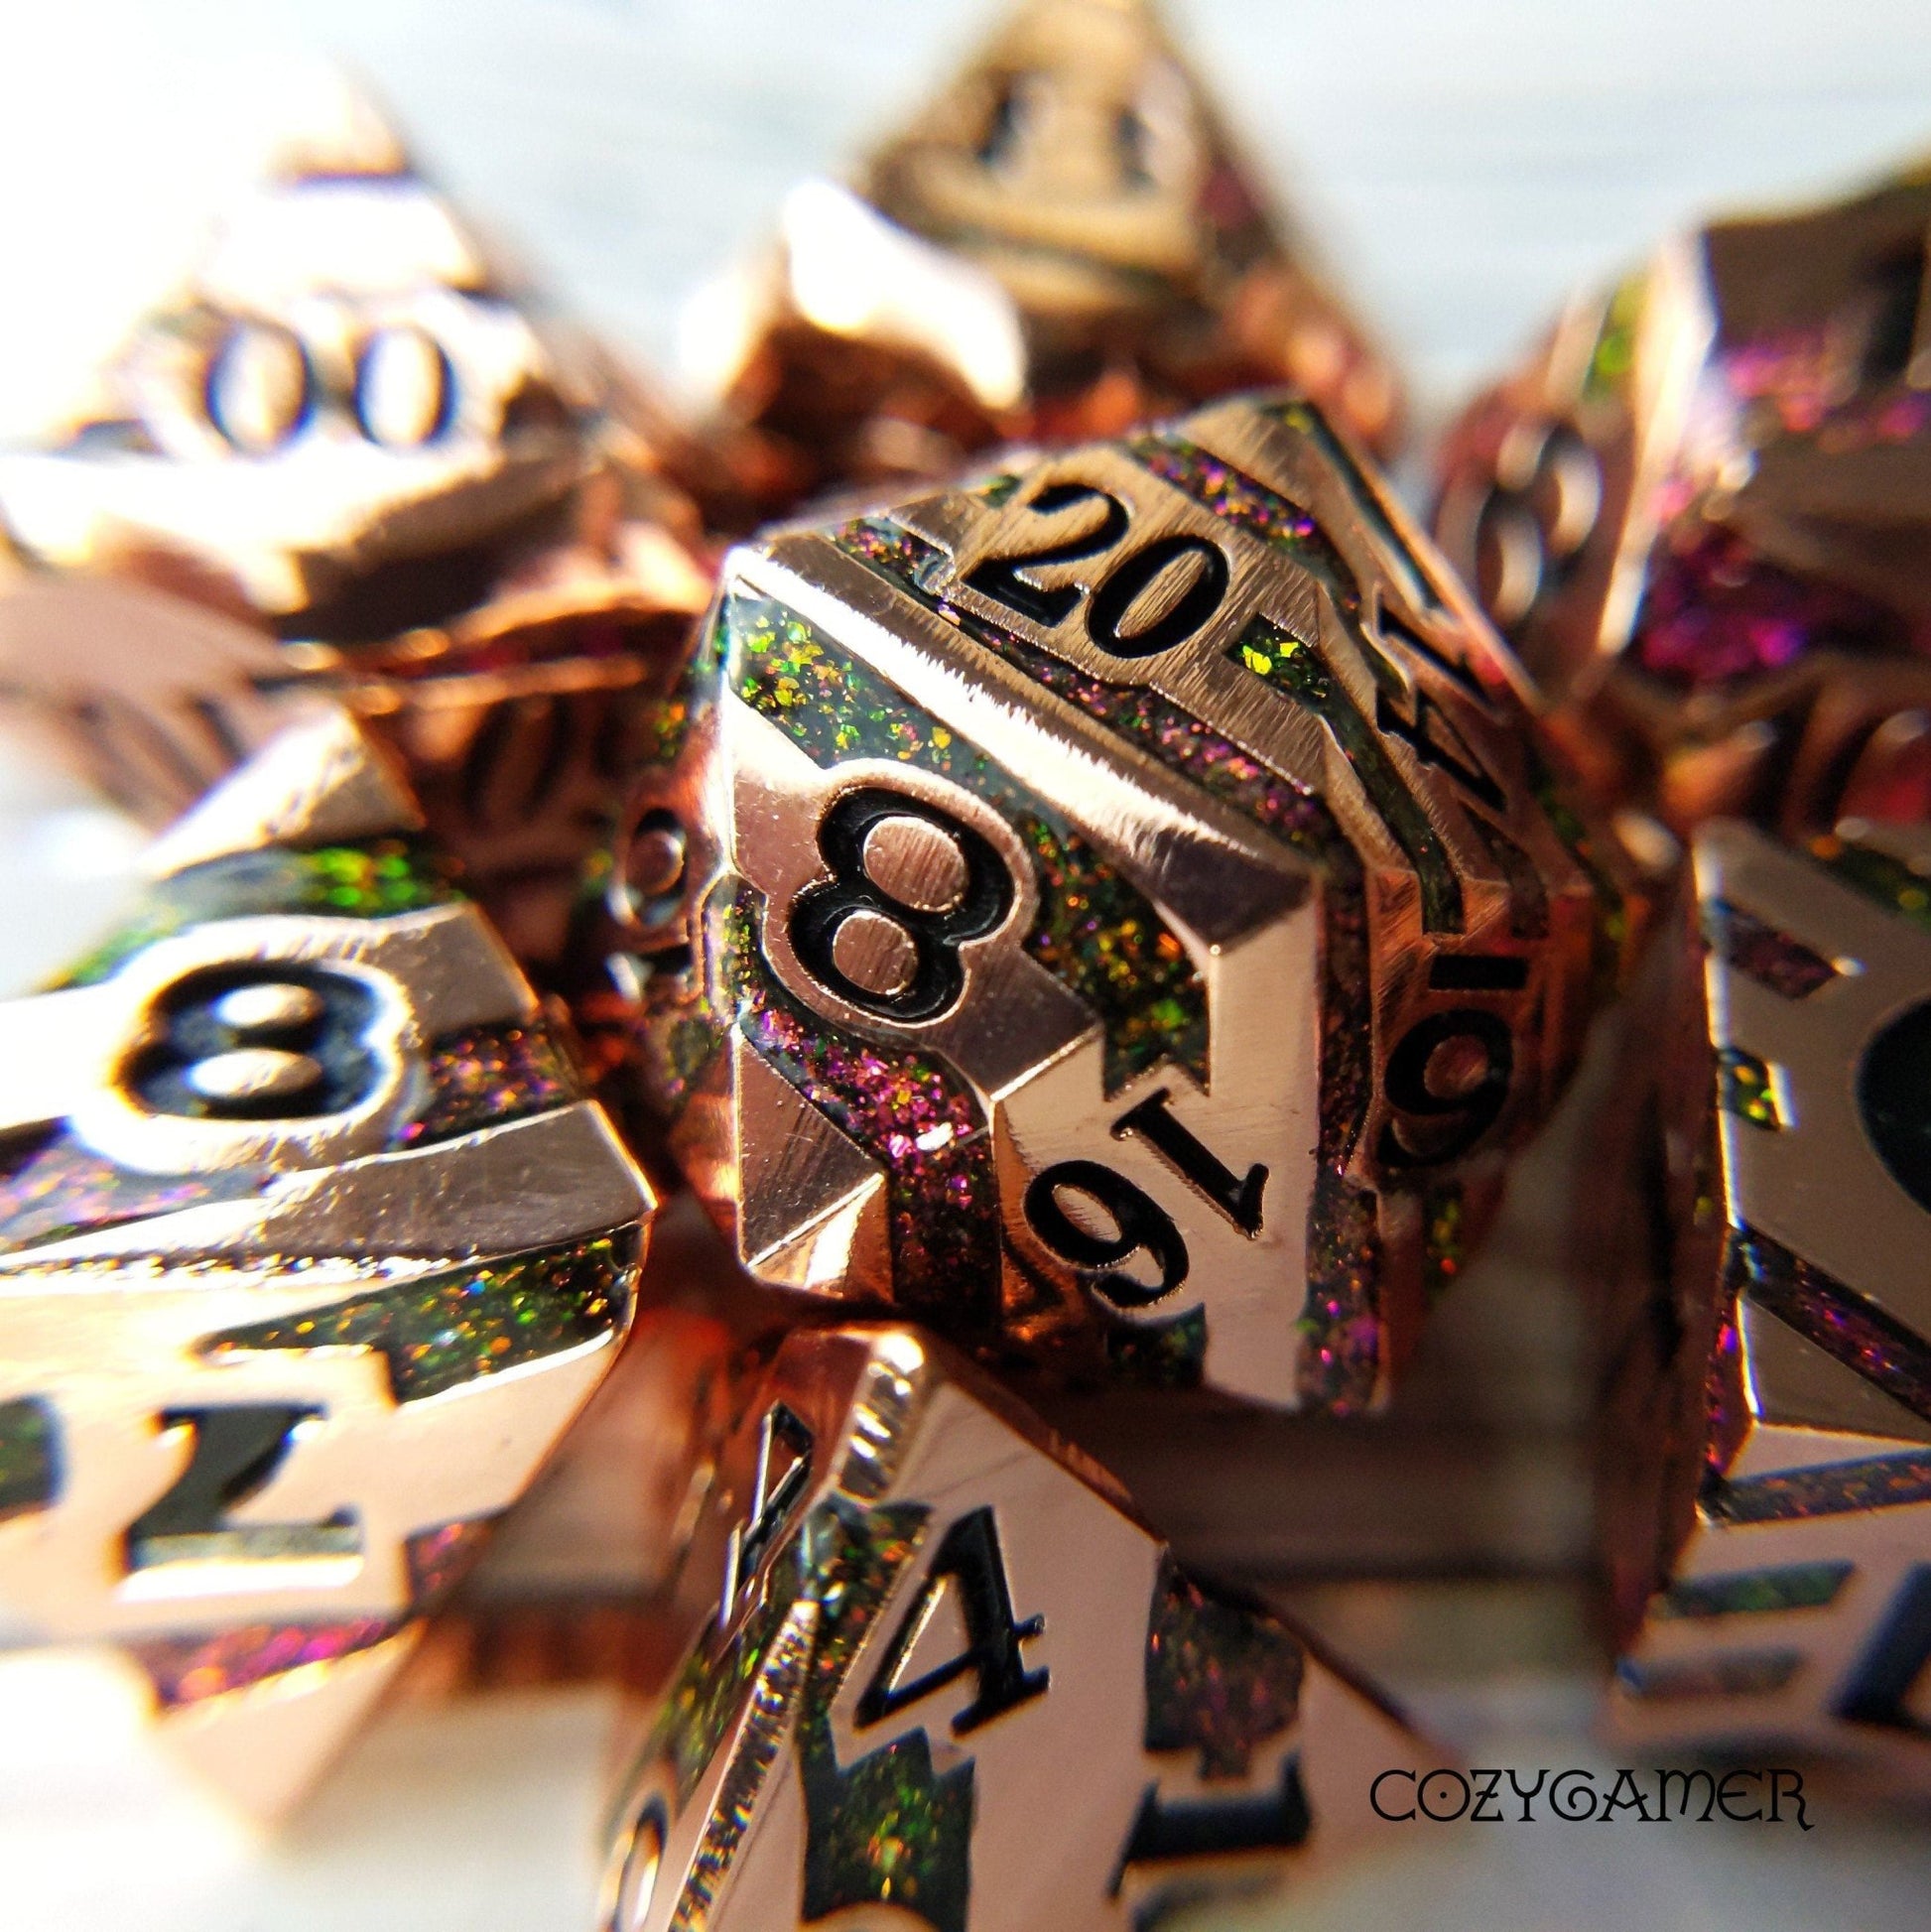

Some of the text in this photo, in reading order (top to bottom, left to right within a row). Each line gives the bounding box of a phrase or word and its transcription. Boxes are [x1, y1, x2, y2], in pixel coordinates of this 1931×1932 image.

[960, 482, 1232, 660] 20
[793, 786, 1015, 1020] 8
[116, 961, 394, 1121] 8
[1022, 1087, 1270, 1308] 16
[853, 1503, 1053, 1735] 4
